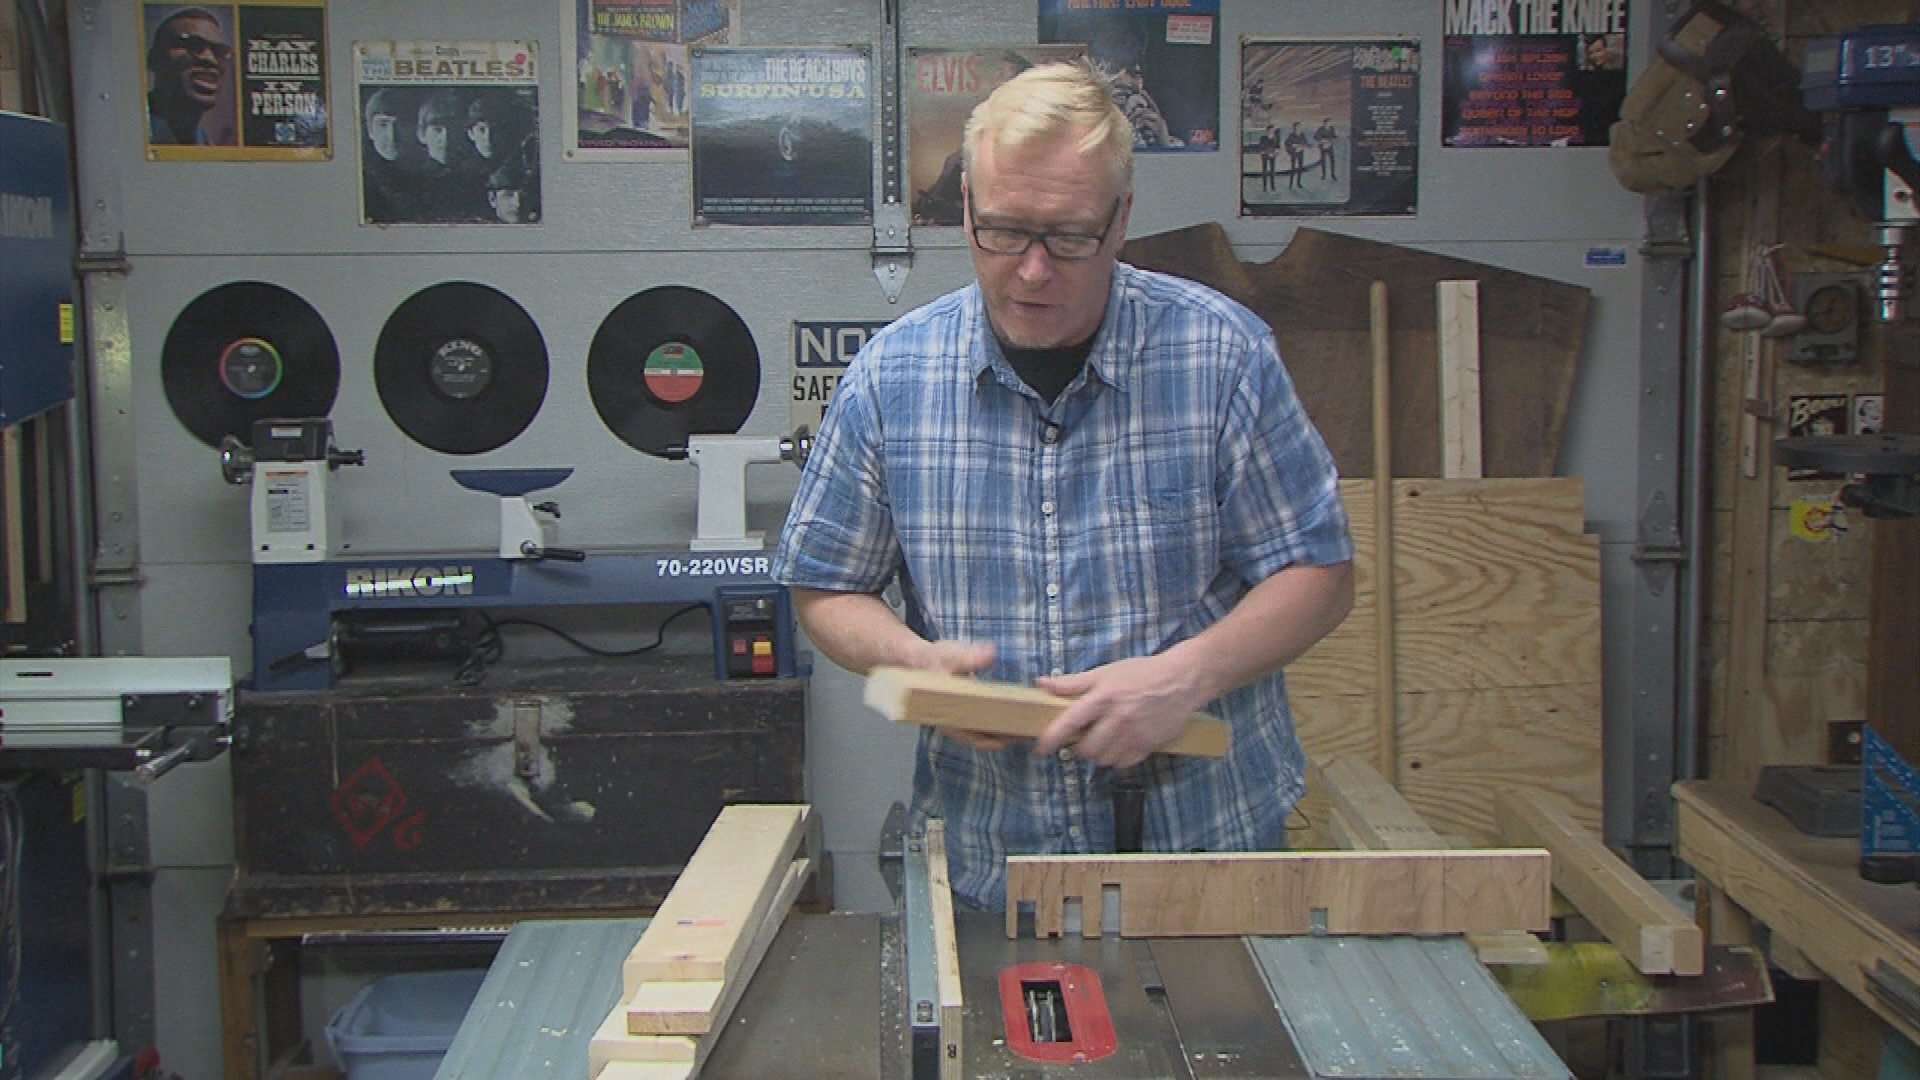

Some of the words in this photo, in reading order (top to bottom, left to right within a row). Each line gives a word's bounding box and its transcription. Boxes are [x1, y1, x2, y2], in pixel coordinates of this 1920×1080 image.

[640, 14, 674, 30] BROWN
[1445, 0, 1513, 34] MACK
[1517, 0, 1558, 34] THE
[1562, 0, 1626, 34] KNIFE
[248, 40, 317, 50] RAY
[248, 52, 319, 73] CHARLES
[395, 59, 535, 77] BEATLES!
[764, 57, 788, 83] THE
[789, 57, 830, 83] BEACH
[831, 58, 866, 83] BOYS
[917, 55, 981, 94] ELVIS
[263, 82, 304, 91] IN
[251, 92, 317, 115] PERSON
[656, 557, 769, 577] 70-220VSR
[345, 566, 474, 598] RIKON
